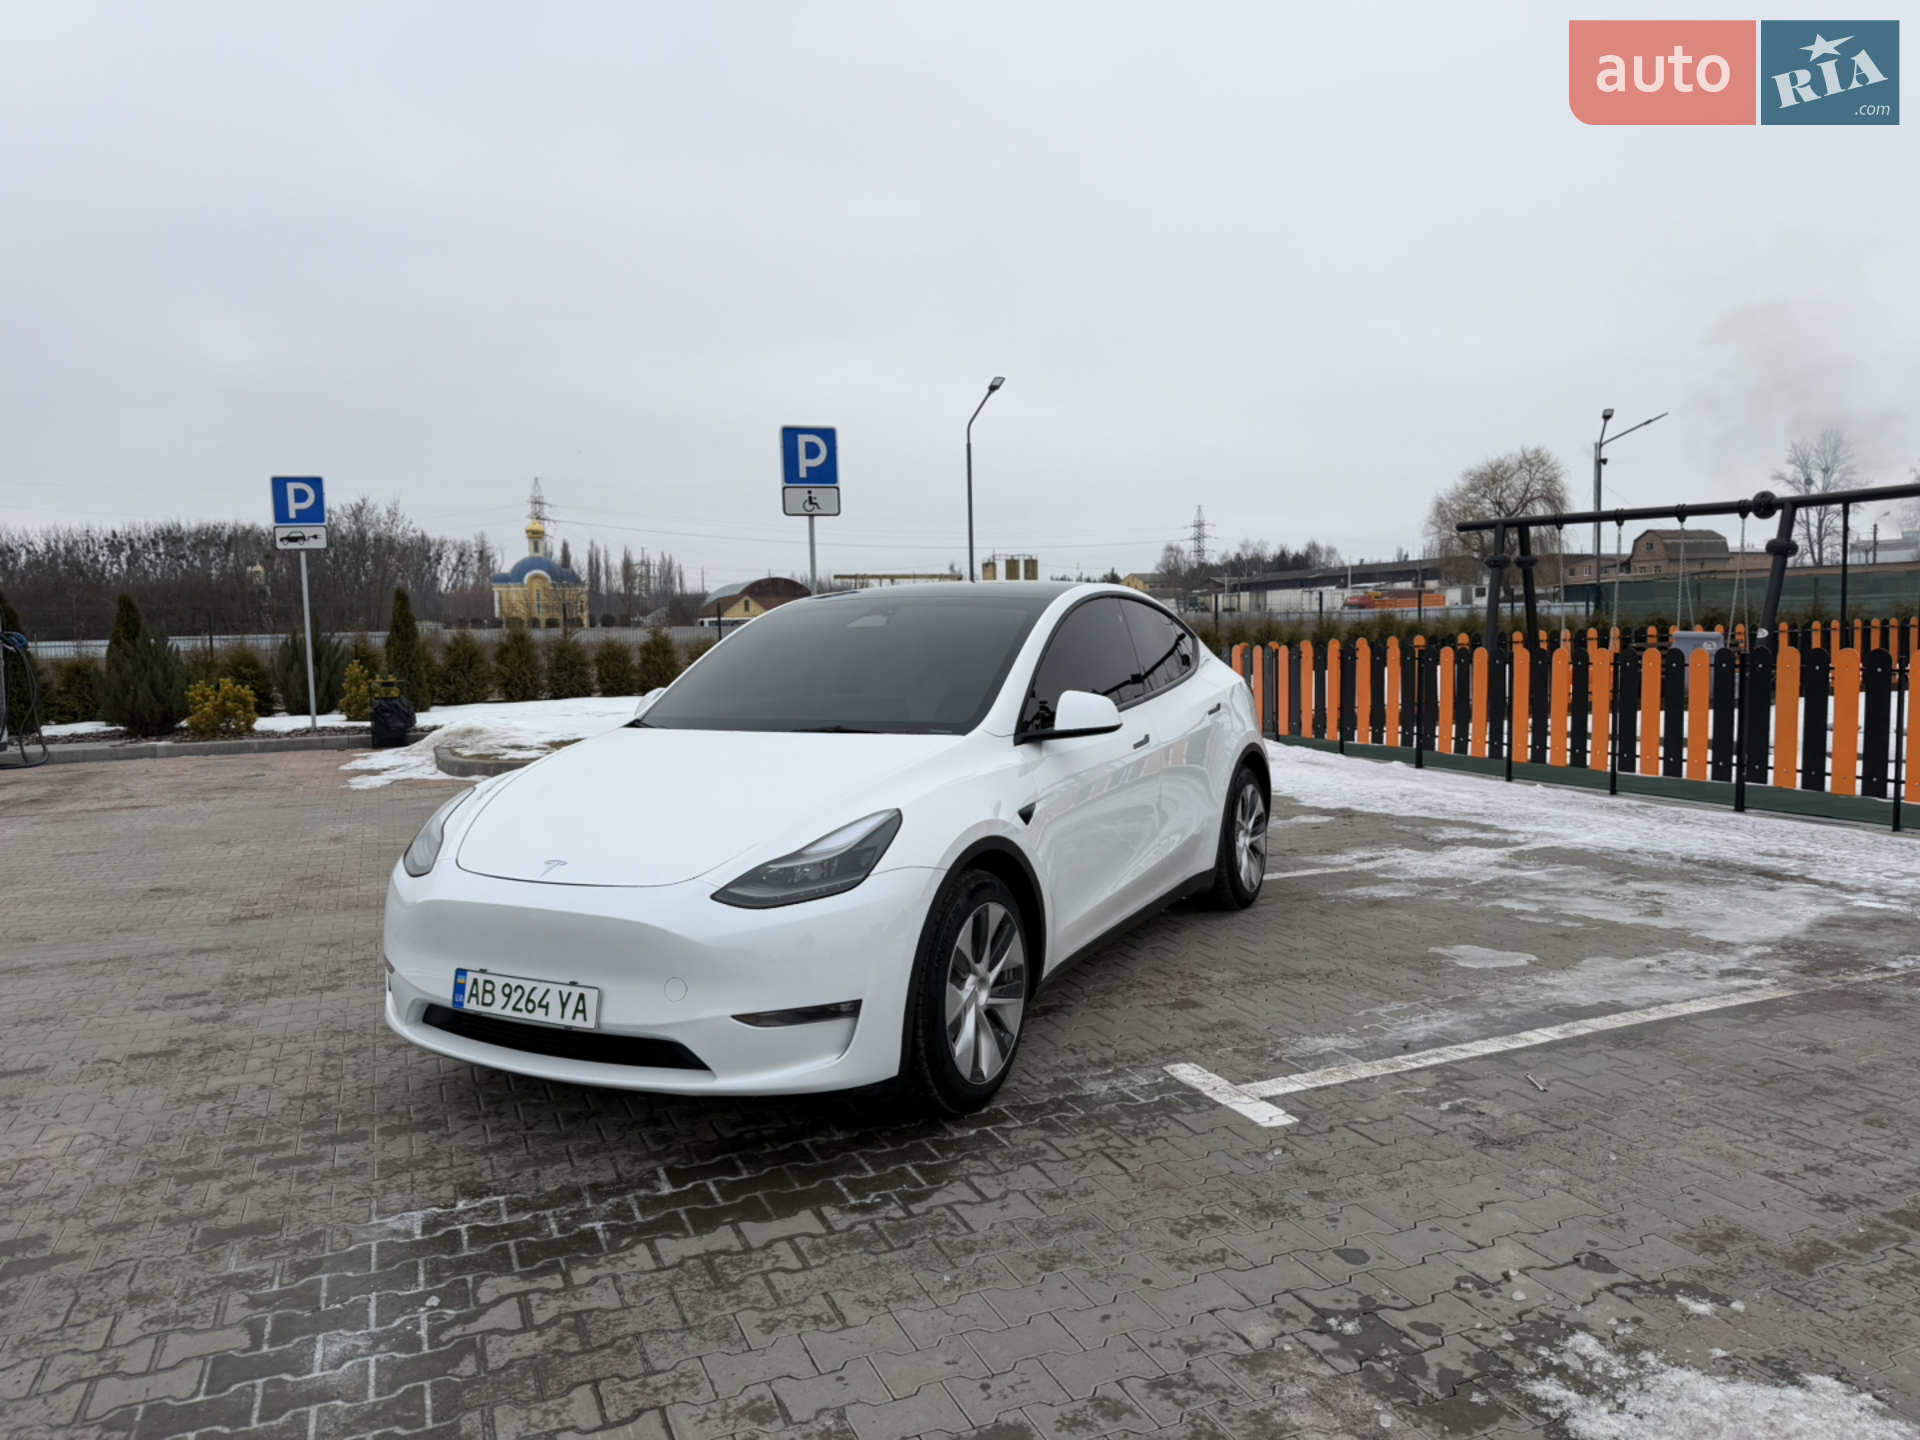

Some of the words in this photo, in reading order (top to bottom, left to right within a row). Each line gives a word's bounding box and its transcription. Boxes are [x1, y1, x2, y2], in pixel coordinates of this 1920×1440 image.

[797, 433, 828, 478] P
[286, 482, 316, 519] P
[467, 977, 496, 1007] AB
[501, 982, 551, 1016] 9264
[558, 990, 587, 1021] YA
